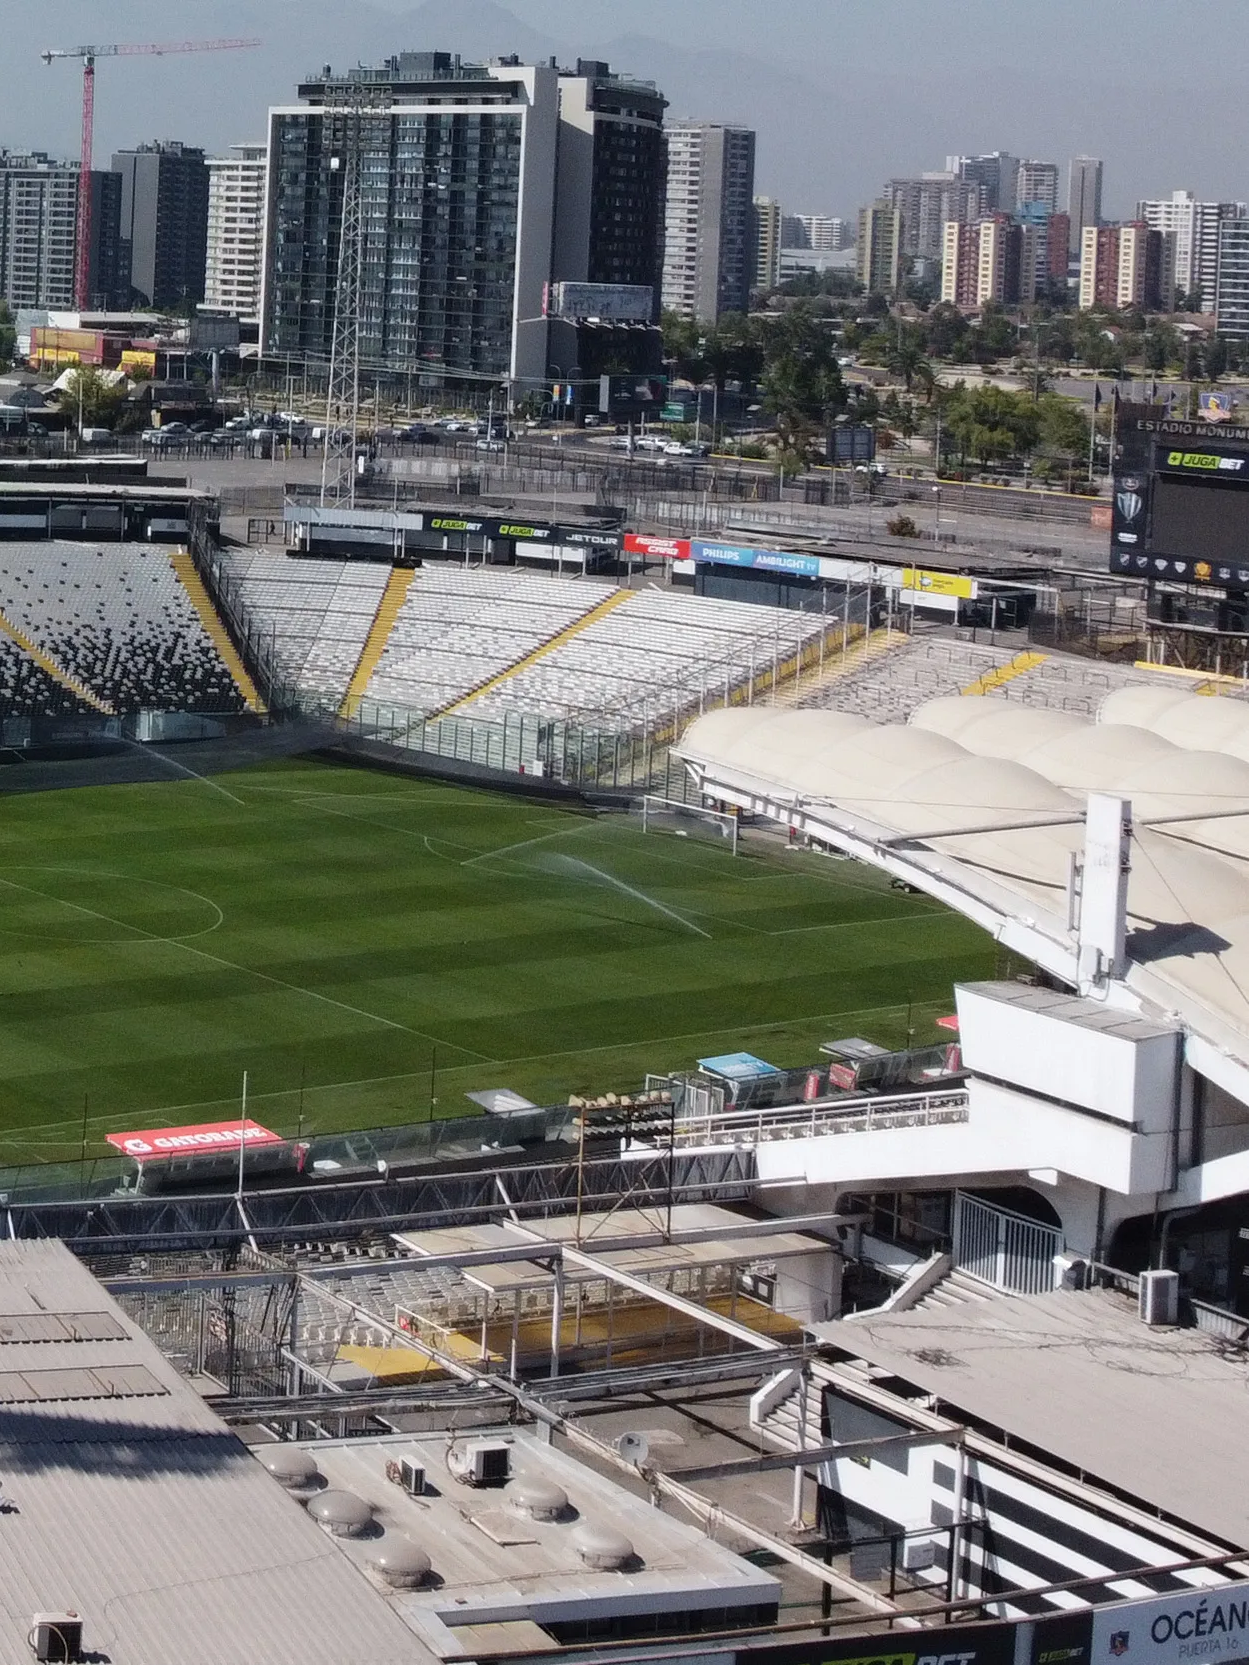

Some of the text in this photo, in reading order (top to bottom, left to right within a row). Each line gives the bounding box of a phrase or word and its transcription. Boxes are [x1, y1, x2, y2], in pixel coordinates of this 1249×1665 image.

[1137, 420, 1249, 440] ESTADIO MONUM
[565, 534, 618, 545] JETOUR
[635, 536, 676, 547] ASSIST
[647, 545, 679, 556] CARD
[702, 547, 740, 561] PHILIPS
[756, 554, 805, 570] AMBILIGHT
[154, 1127, 268, 1149] GATORADE
[1151, 1598, 1249, 1644] OCÉAN
[1178, 1639, 1221, 1659] PUERTA
